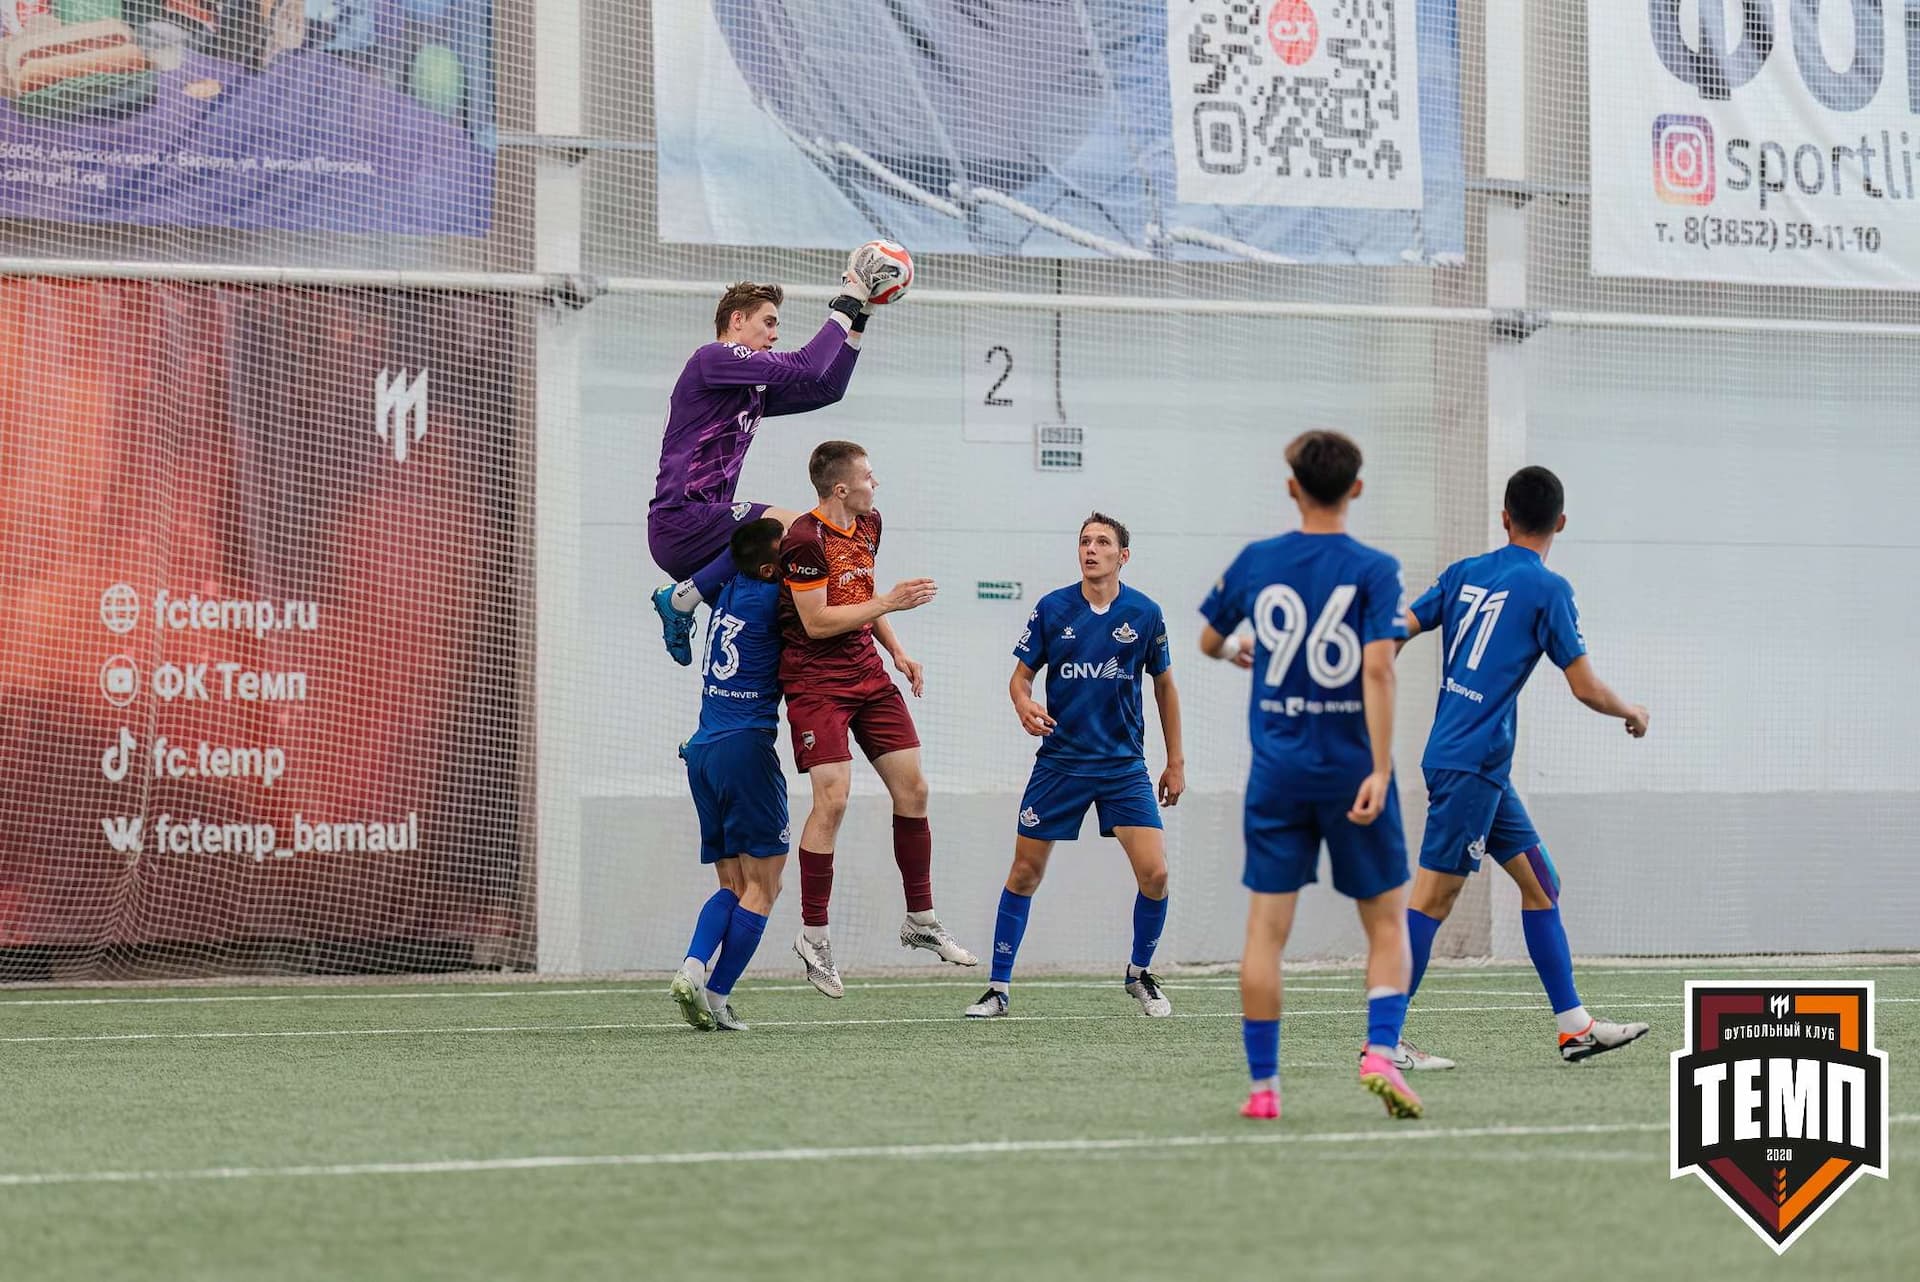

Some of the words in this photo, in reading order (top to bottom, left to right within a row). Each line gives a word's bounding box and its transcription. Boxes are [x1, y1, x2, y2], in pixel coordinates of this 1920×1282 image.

[1726, 130, 1920, 210] sportli
[1655, 222, 1675, 243] т.
[1684, 214, 1779, 250] 8(3852)
[1785, 223, 1882, 252] 59-11-10
[984, 345, 1013, 407] 2
[154, 589, 319, 639] fctemp.ru
[1253, 583, 1363, 689] 96
[1448, 584, 1510, 671] 71
[152, 661, 211, 702] ФК
[215, 661, 307, 701] Темп
[1060, 662, 1104, 680] GNV
[153, 737, 286, 788] fc.temp
[155, 811, 418, 863] fctemp_barnaul
